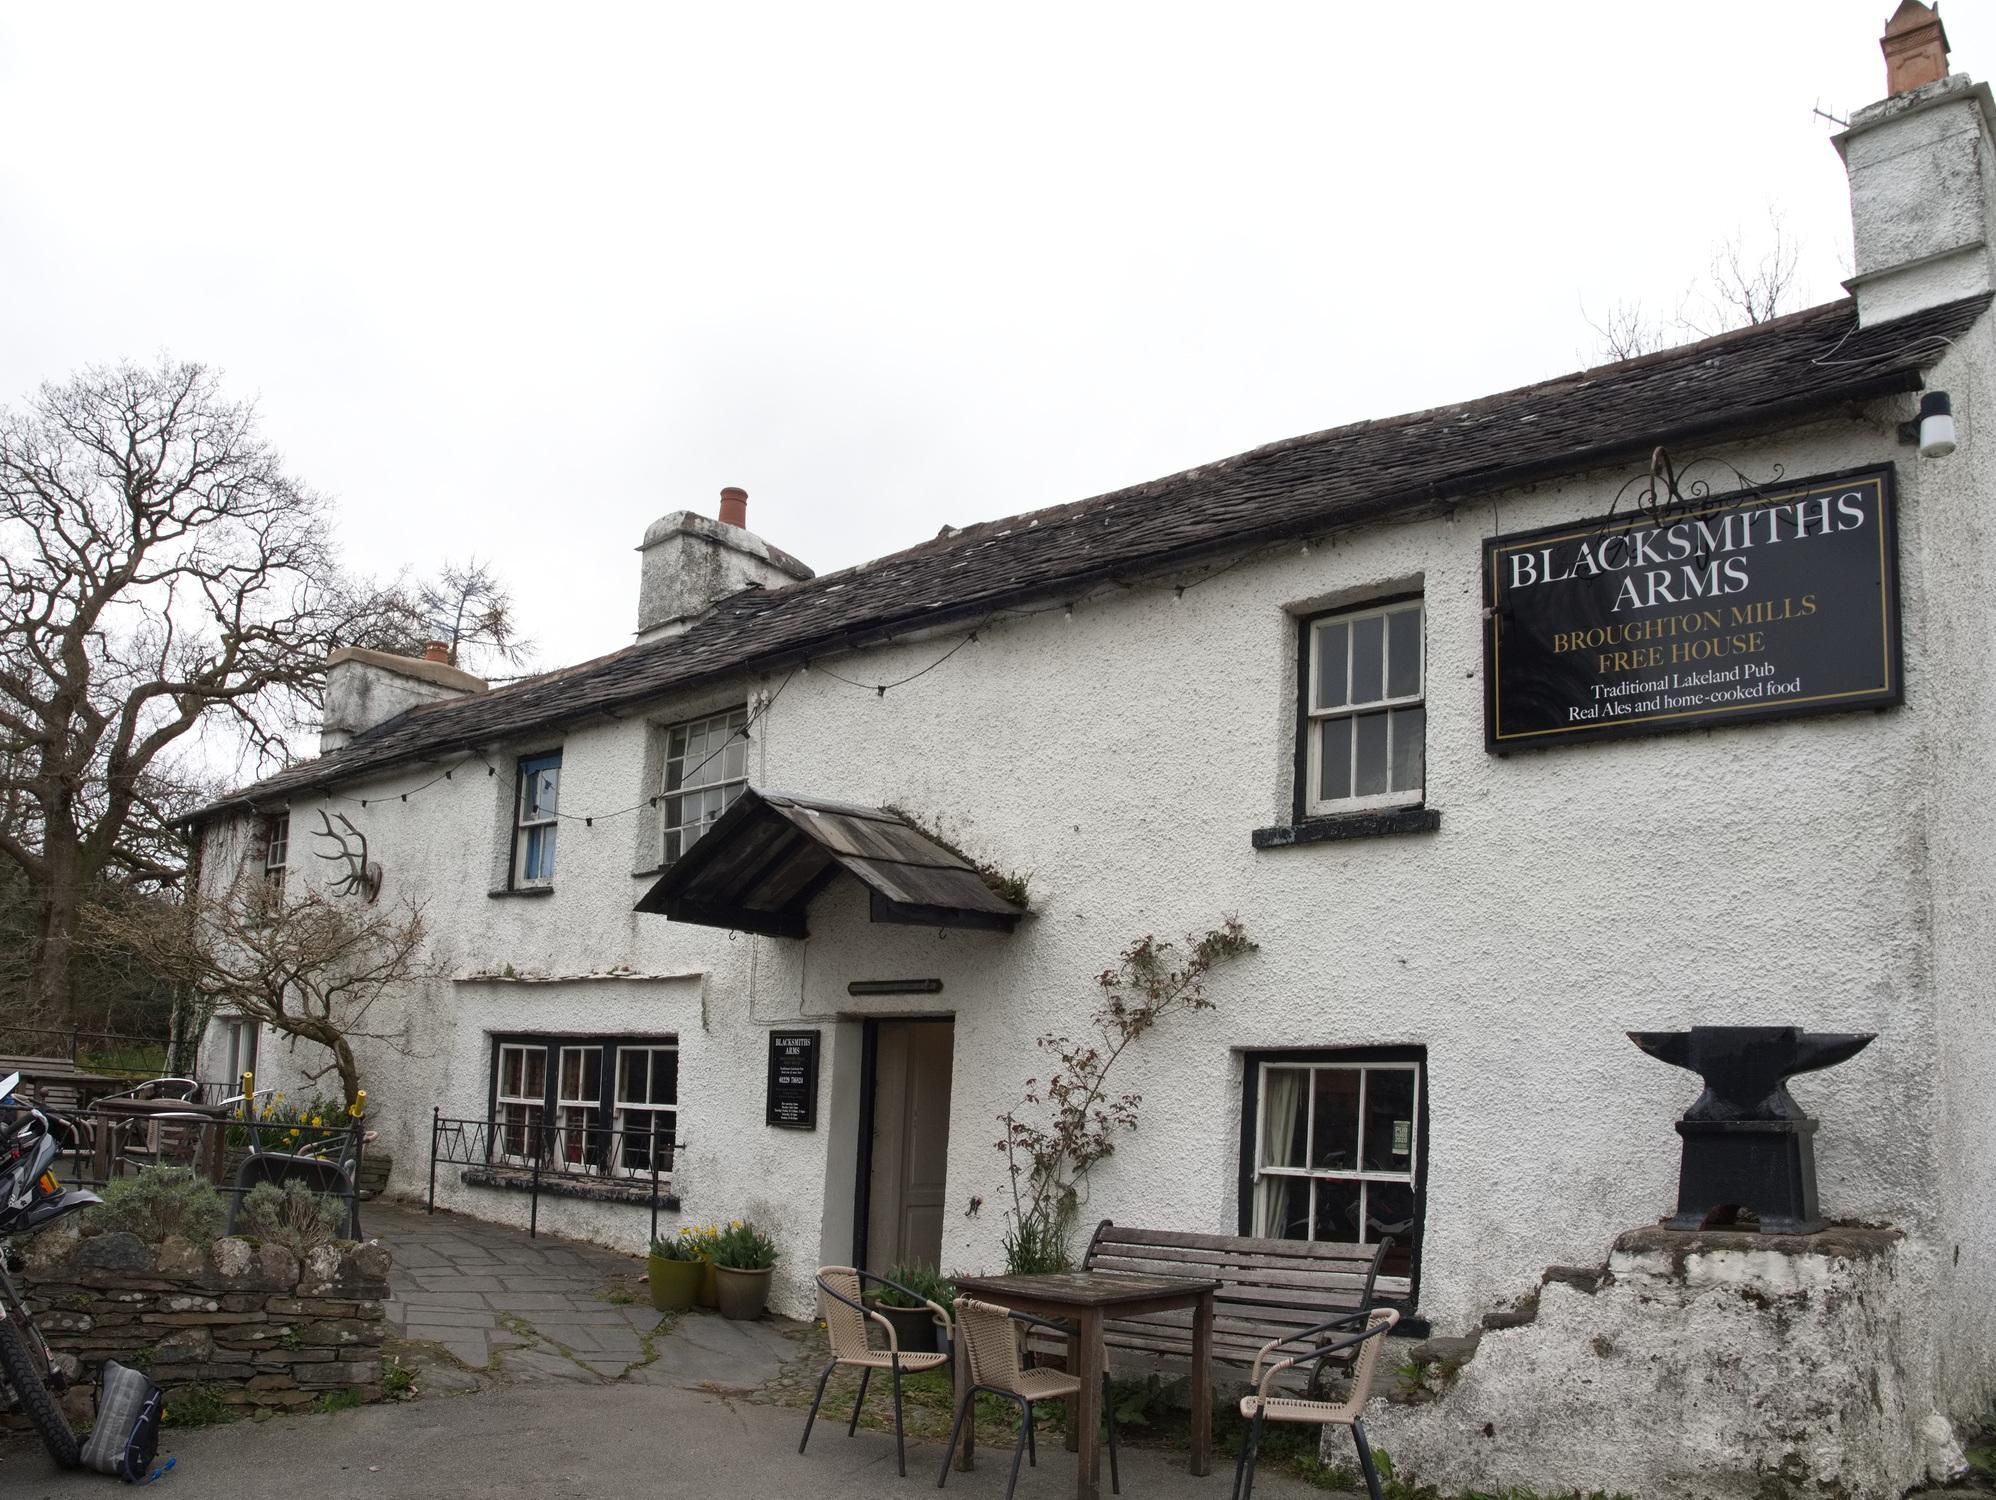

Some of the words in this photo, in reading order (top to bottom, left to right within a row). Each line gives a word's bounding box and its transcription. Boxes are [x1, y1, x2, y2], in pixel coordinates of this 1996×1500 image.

[1509, 491, 1865, 589] BLACKSMITHS
[1611, 556, 1749, 612] ARMS
[1553, 609, 1722, 653] BROUGHTON
[1731, 595, 1816, 627] MILLS
[1599, 646, 1664, 674] FREE
[1671, 631, 1766, 664] HOUSE
[1568, 704, 1599, 721] Real
[1602, 701, 1631, 717] Ales
[1635, 695, 1660, 713] and
[1664, 682, 1763, 709] home-cooked
[1767, 677, 1801, 696] food
[1591, 675, 1668, 699] Traditional
[1673, 666, 1740, 689] Lakeland
[1744, 661, 1775, 679] Pub
[775, 1038, 811, 1046] BLACKSMITHS
[785, 1047, 800, 1055] ARMS
